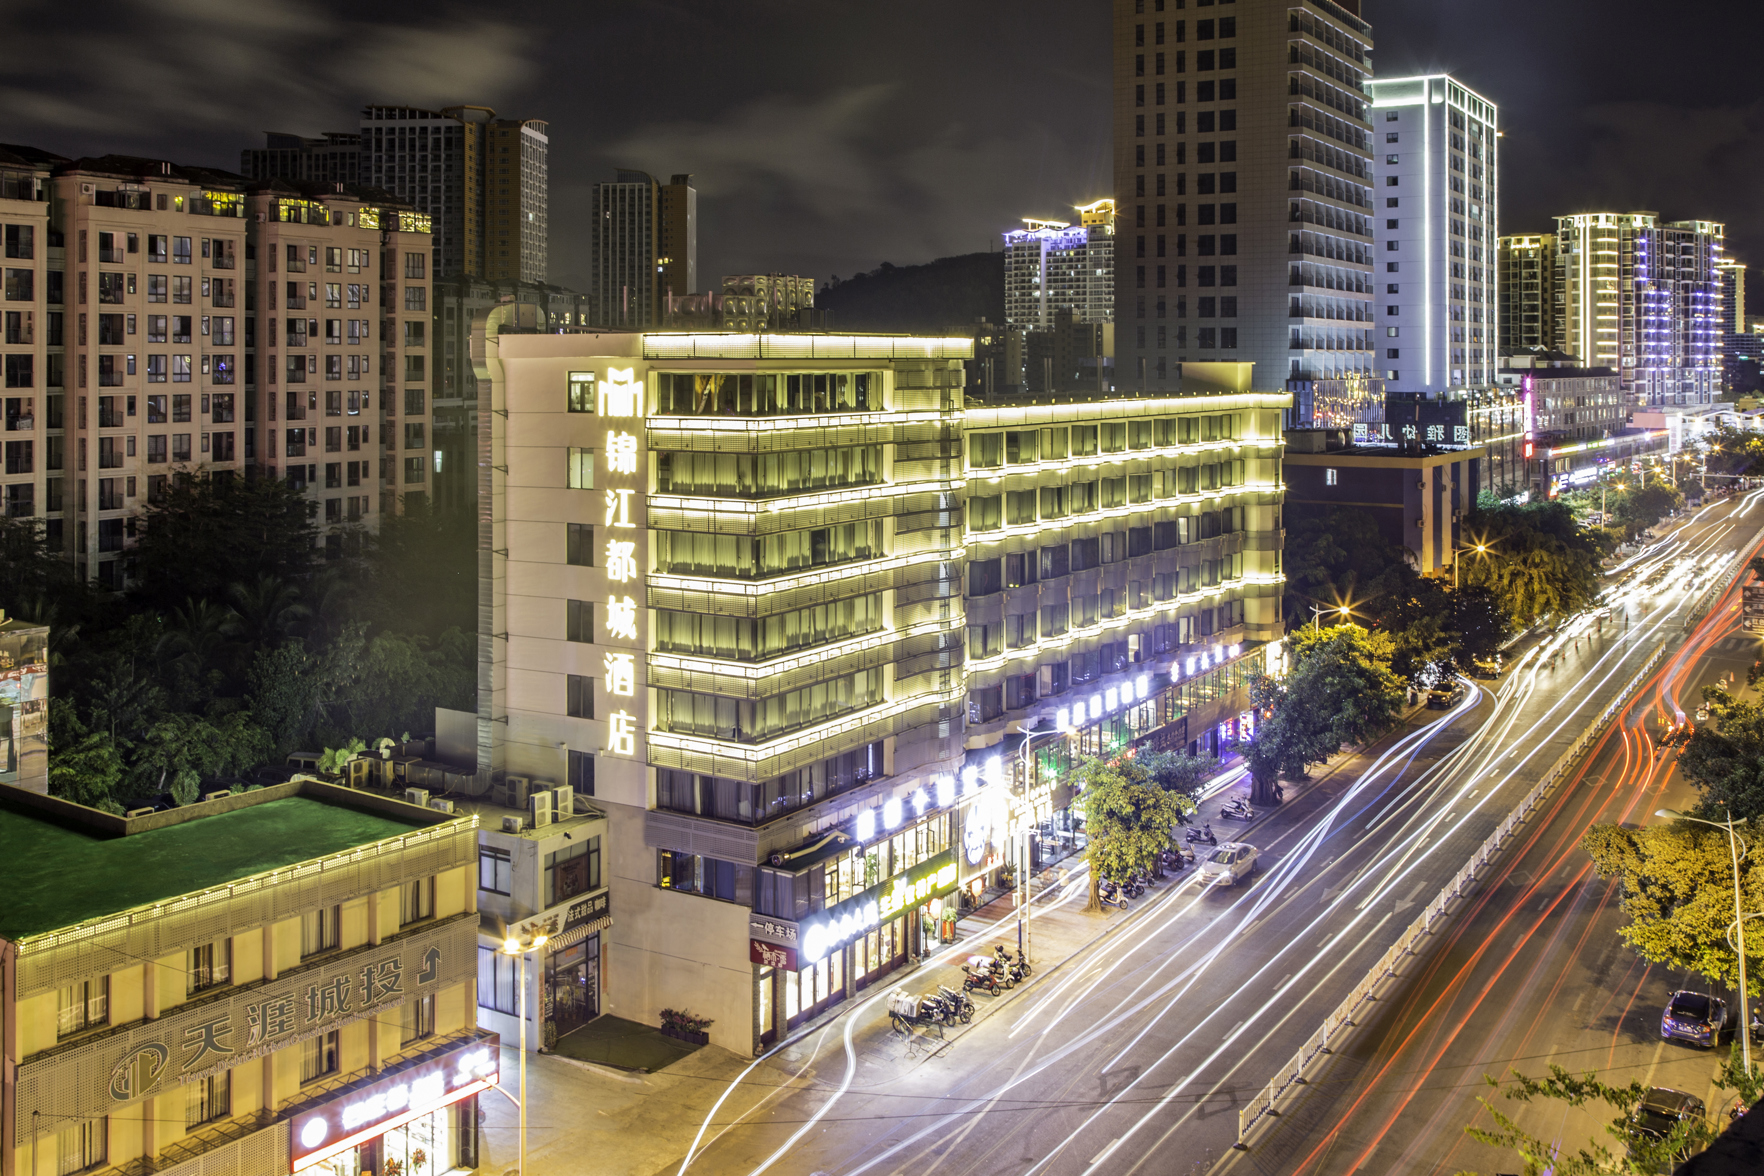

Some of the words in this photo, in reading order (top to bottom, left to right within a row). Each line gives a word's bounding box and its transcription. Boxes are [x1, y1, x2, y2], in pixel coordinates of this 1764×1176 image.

[604, 430, 638, 756] 锦江都城酒店
[765, 922, 797, 940] 停车场
[179, 1066, 217, 1085] Tianya
[218, 1050, 257, 1072] District
[259, 1039, 289, 1057] Urban
[290, 1017, 352, 1045] Construction
[354, 996, 406, 1021] Investment
[182, 957, 404, 1071] 天涯城投
